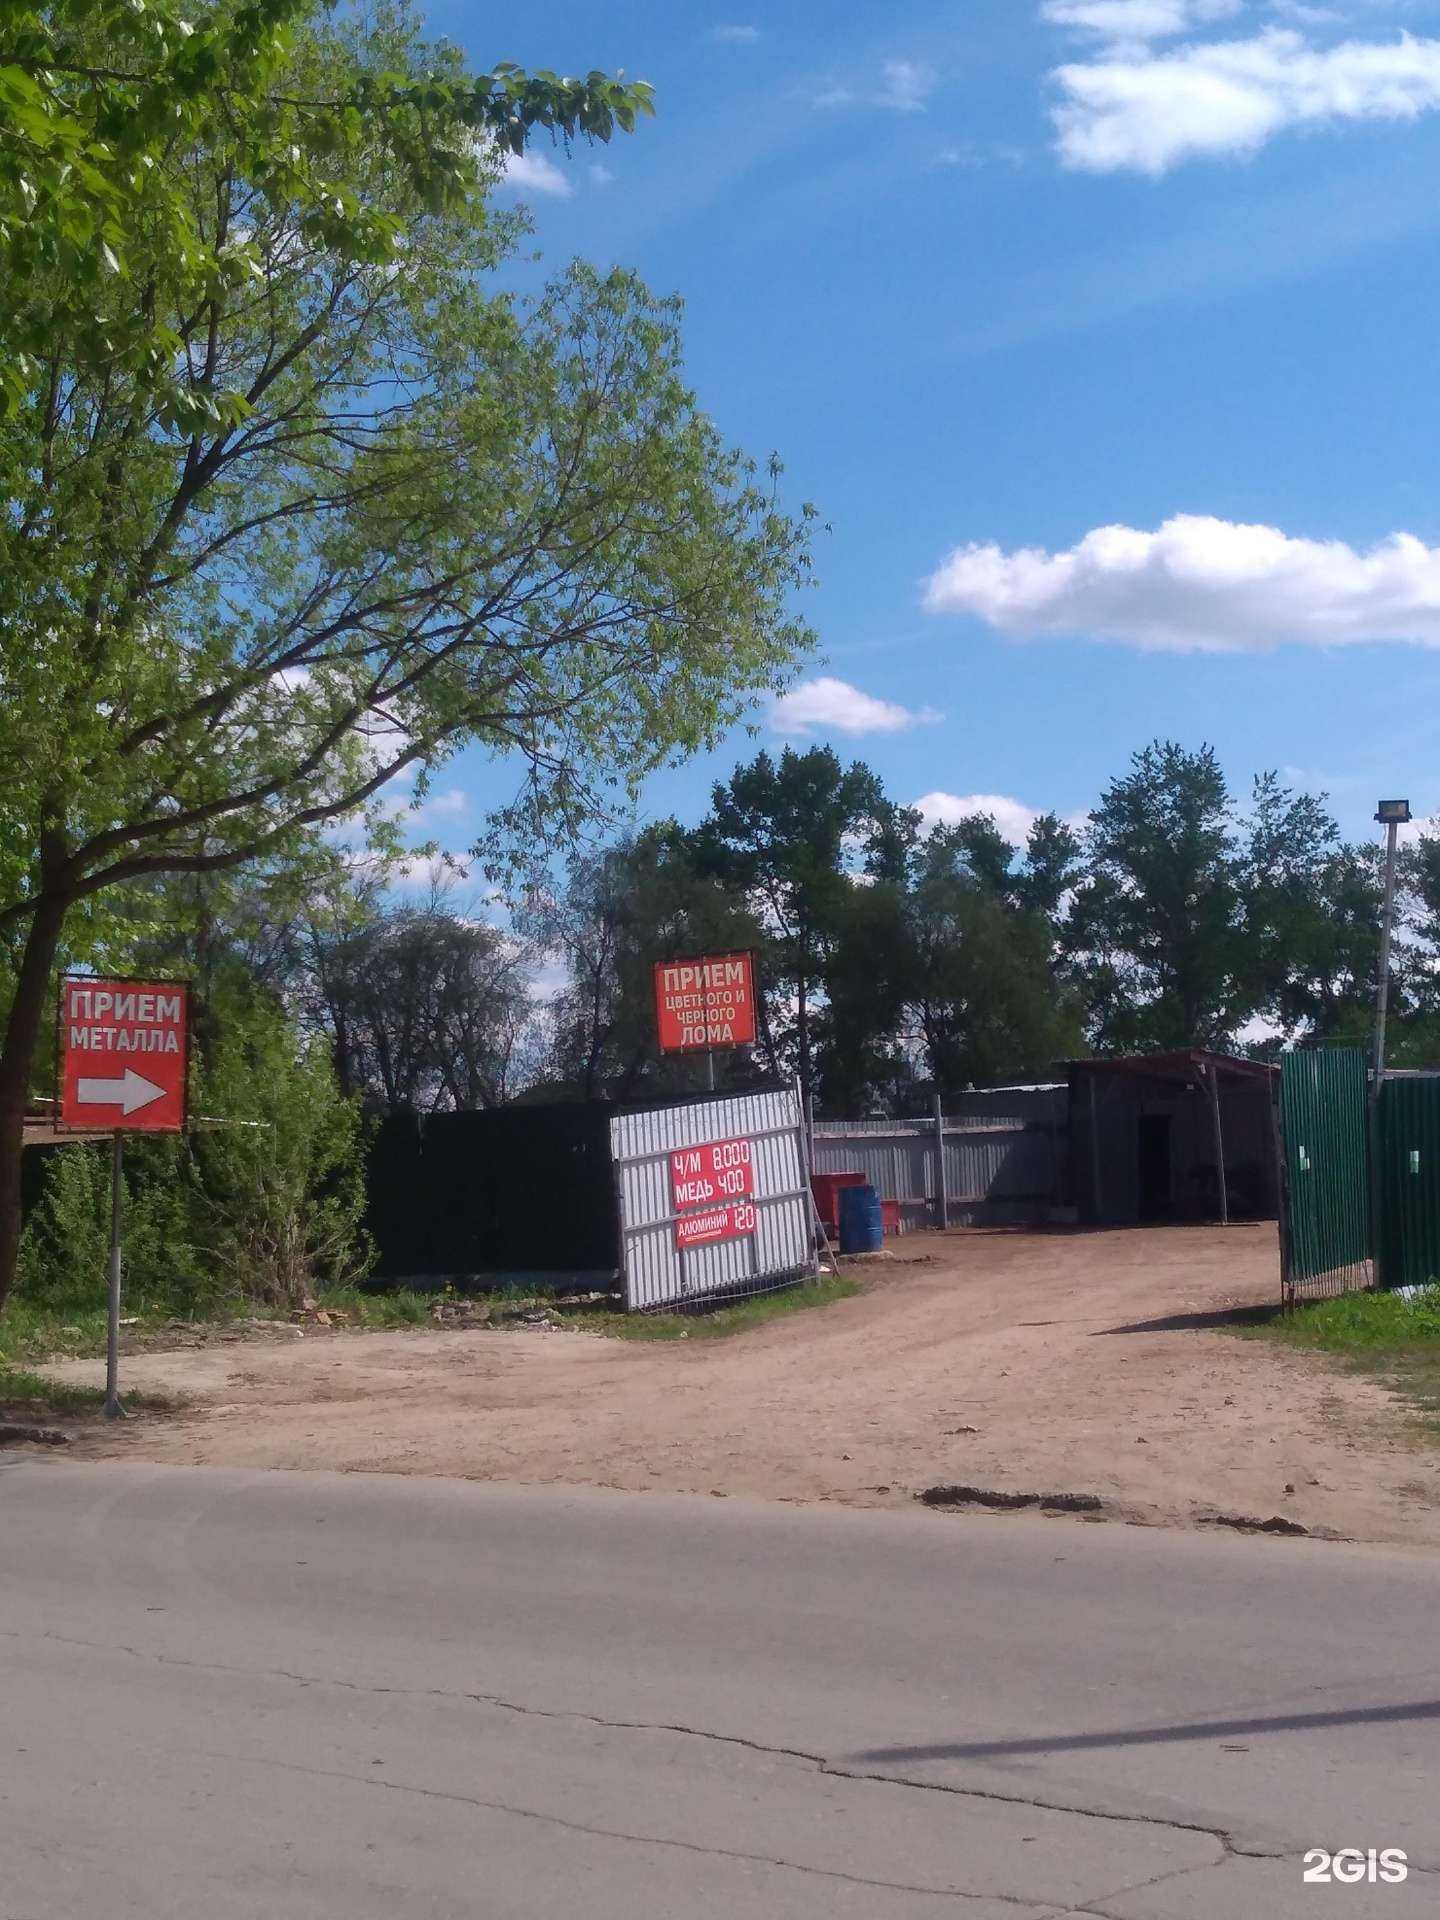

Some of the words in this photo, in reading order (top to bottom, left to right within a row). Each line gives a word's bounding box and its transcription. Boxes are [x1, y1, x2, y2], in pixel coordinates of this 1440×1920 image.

[663, 961, 744, 992] ПРИЕМ
[71, 989, 181, 1024] ПРИЕМ
[736, 989, 745, 1003] И
[676, 1007, 736, 1024] ЧЕРНОГО
[70, 1025, 180, 1053] МЕТАЛЛА
[681, 1023, 734, 1045] ЛОМА
[674, 1152, 702, 1180] Ч/М
[676, 1179, 714, 1203] МЕДЬ
[718, 1169, 745, 1194] 400
[678, 1210, 728, 1237] АЛЮМИНИЙ
[734, 1205, 755, 1230] 120
